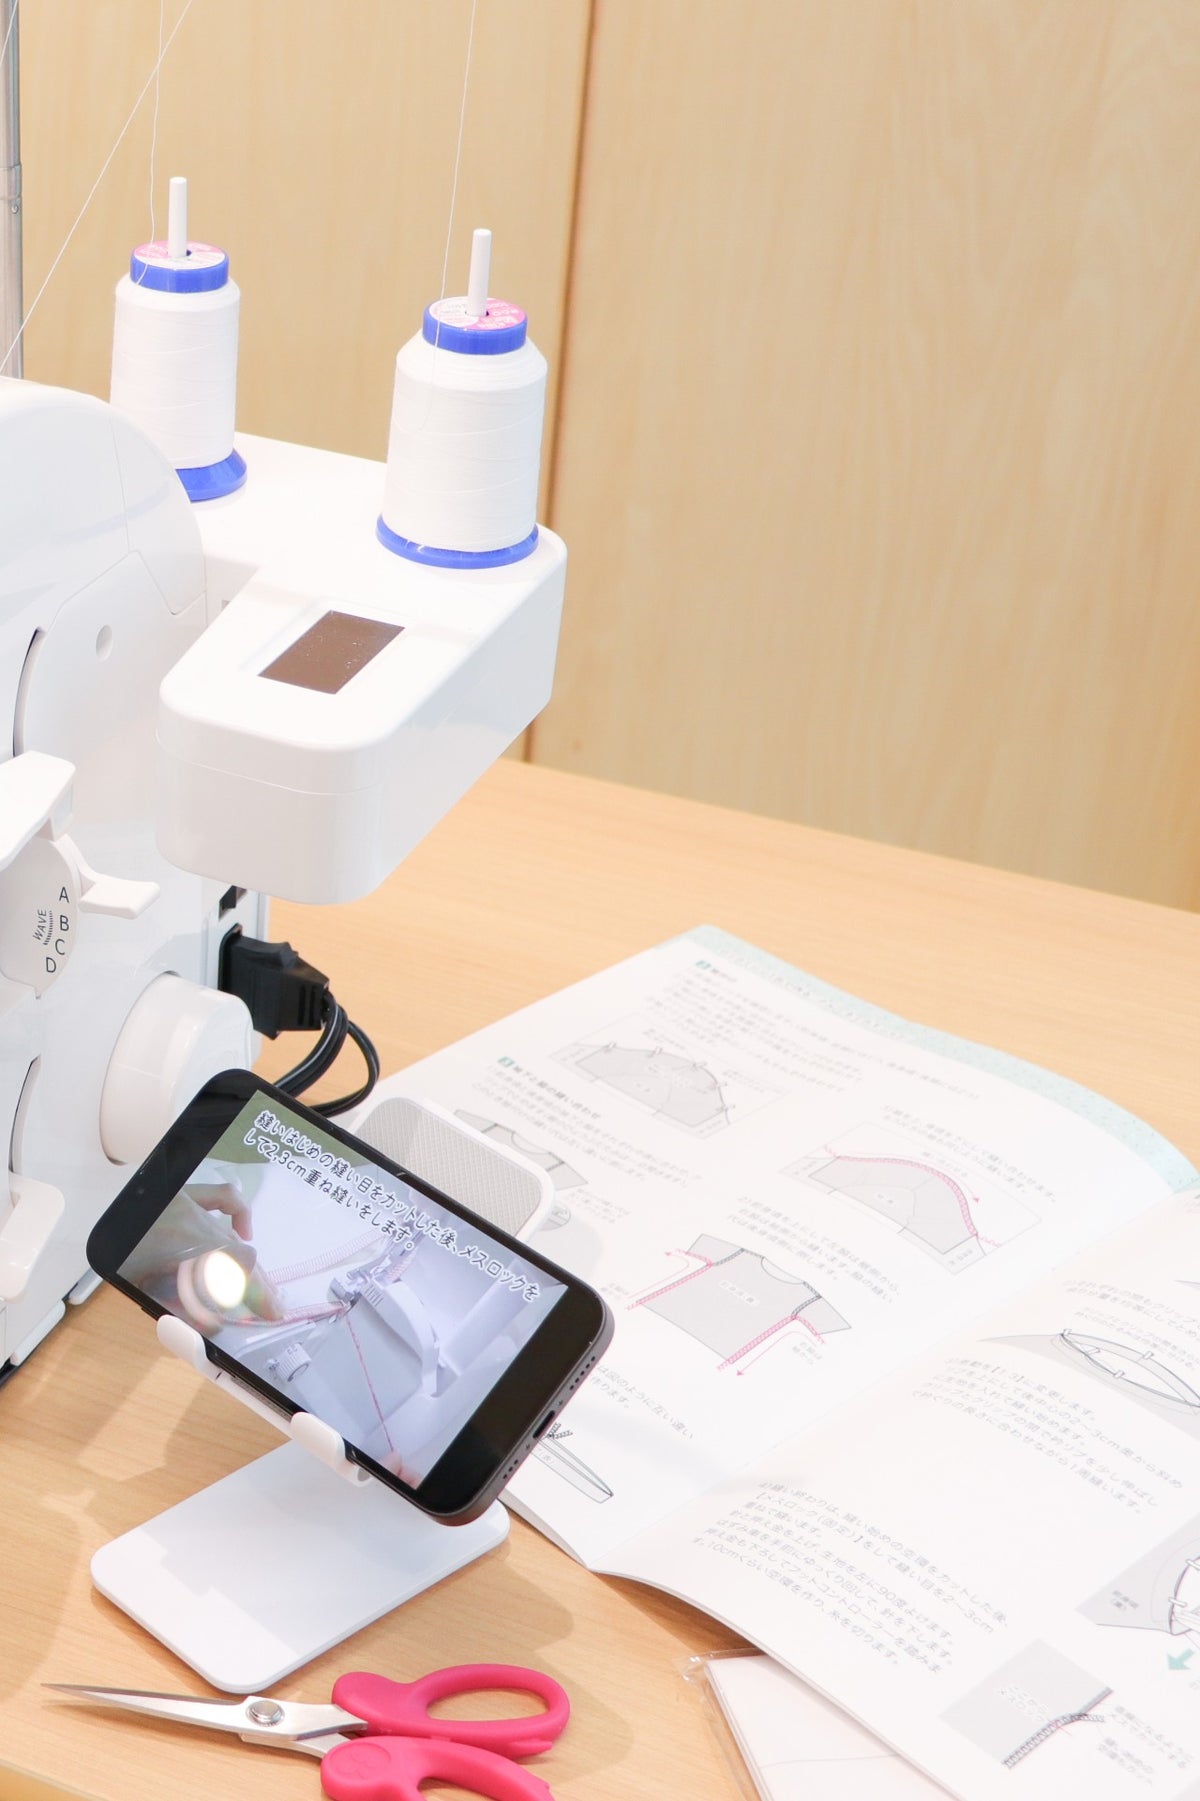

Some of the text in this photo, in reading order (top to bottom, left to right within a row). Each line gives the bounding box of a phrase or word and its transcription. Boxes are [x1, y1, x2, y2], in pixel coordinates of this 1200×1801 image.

[58, 886, 70, 904] A
[32, 908, 47, 941] WAVE
[59, 914, 70, 932] B
[54, 938, 66, 956] C
[45, 956, 57, 974] D
[243, 1129, 415, 1252] して2,3cm重ね縫いをします。
[255, 1110, 541, 1303] 縫いはじめの縫い目をカットした後、メスロックを
